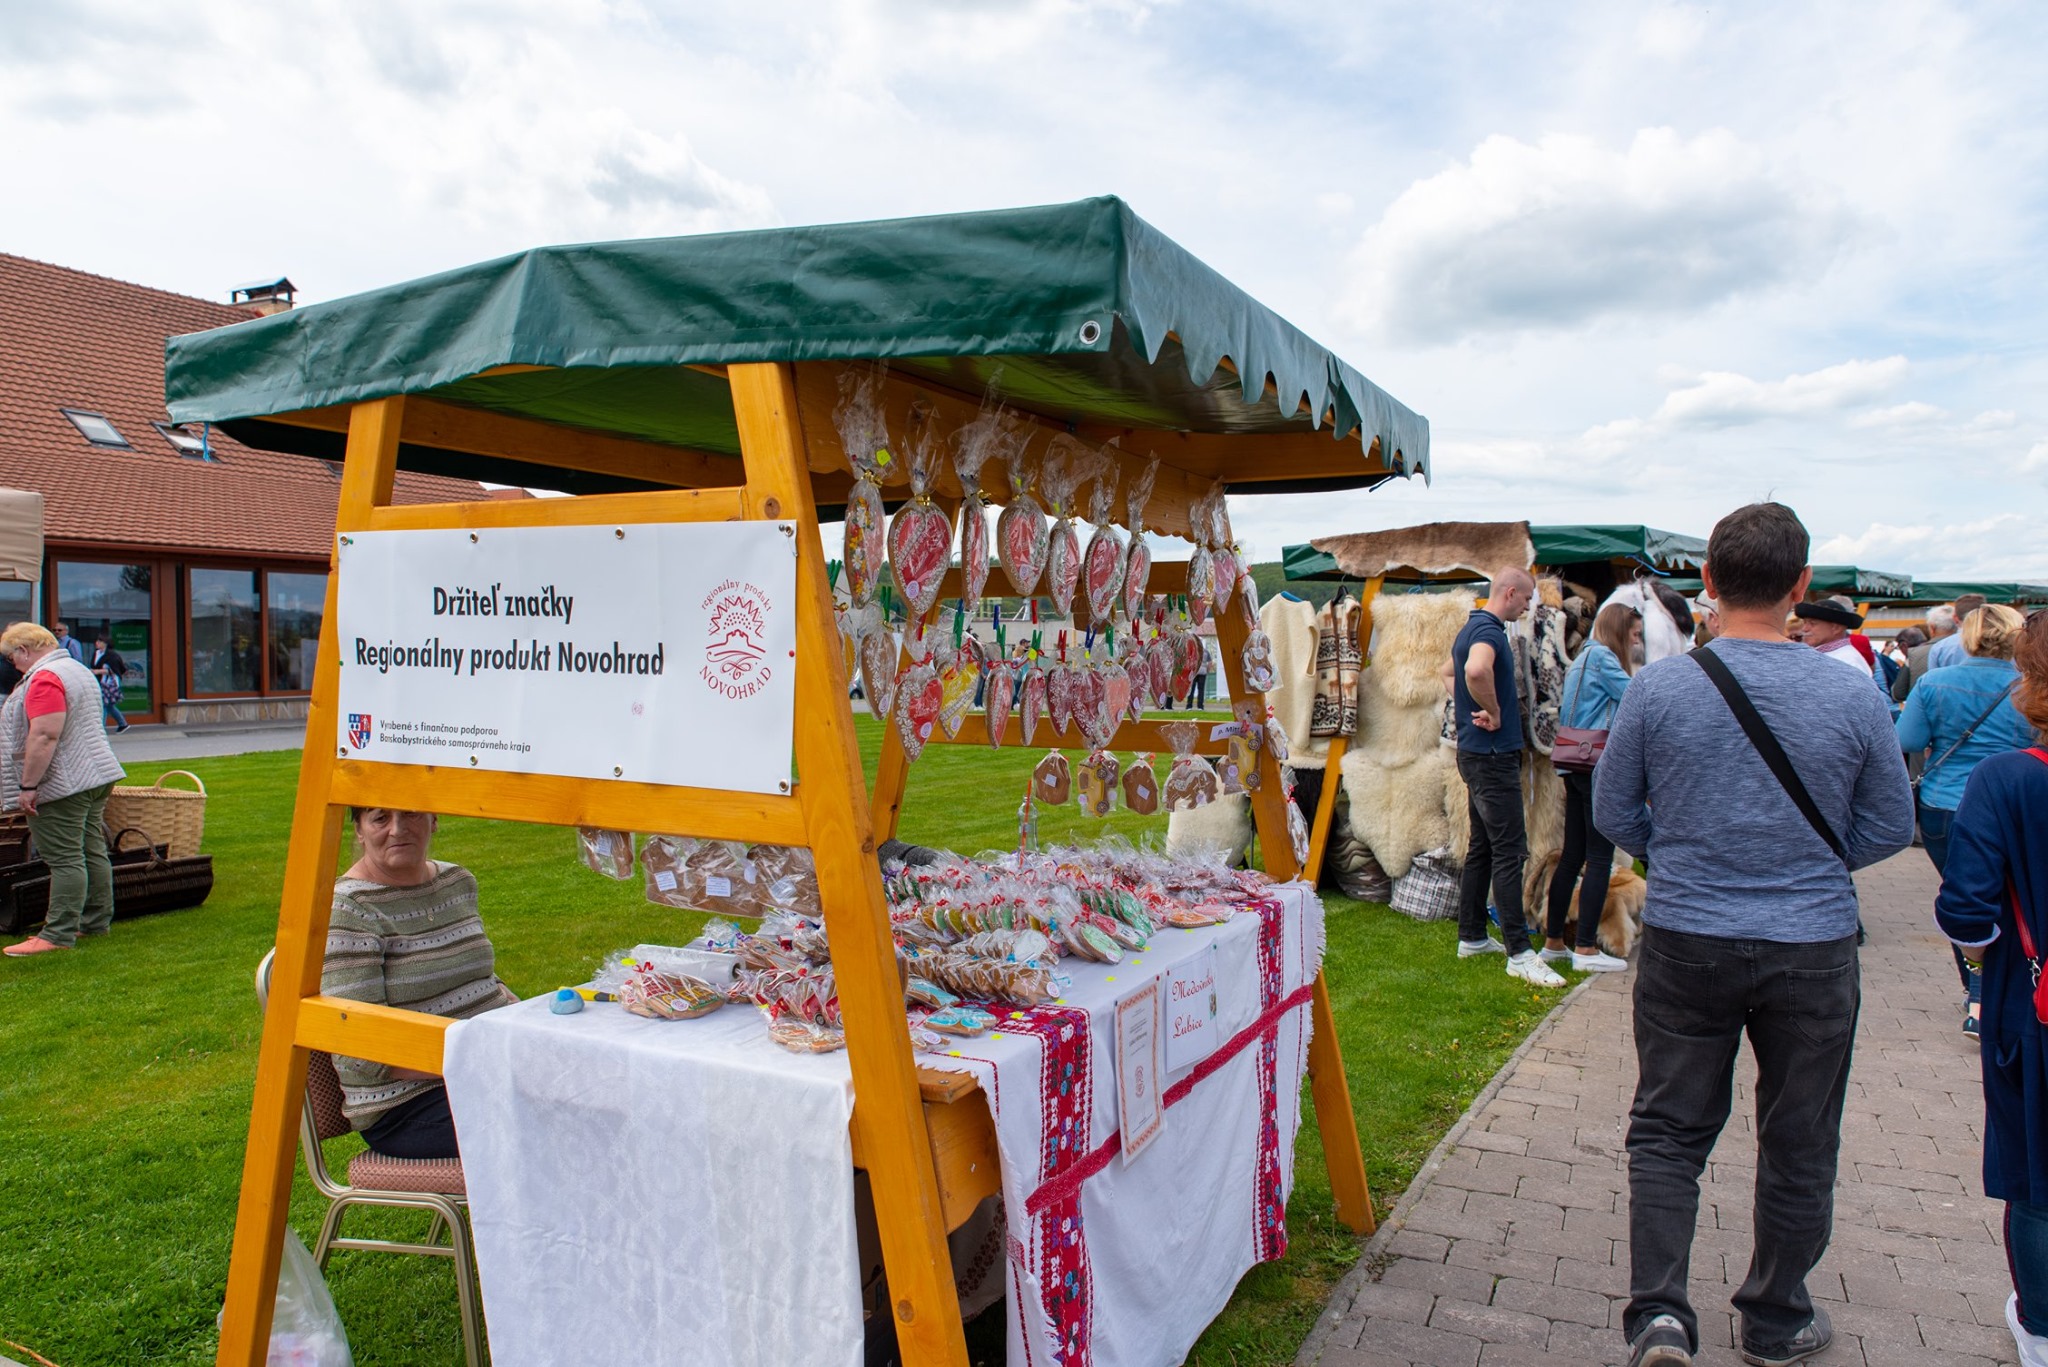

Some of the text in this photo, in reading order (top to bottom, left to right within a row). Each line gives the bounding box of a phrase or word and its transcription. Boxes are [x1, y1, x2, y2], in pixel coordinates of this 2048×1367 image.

[433, 582, 574, 625] Držiteľ značky
[701, 579, 772, 612] regionálny produkt
[355, 637, 664, 676] Regionálny produkt Novohrad
[699, 665, 771, 699] NOVOHRAD
[380, 719, 499, 737] Vyrobené s finančnou podporou
[448, 737, 509, 751] samosprávneho
[509, 742, 532, 753] kraja
